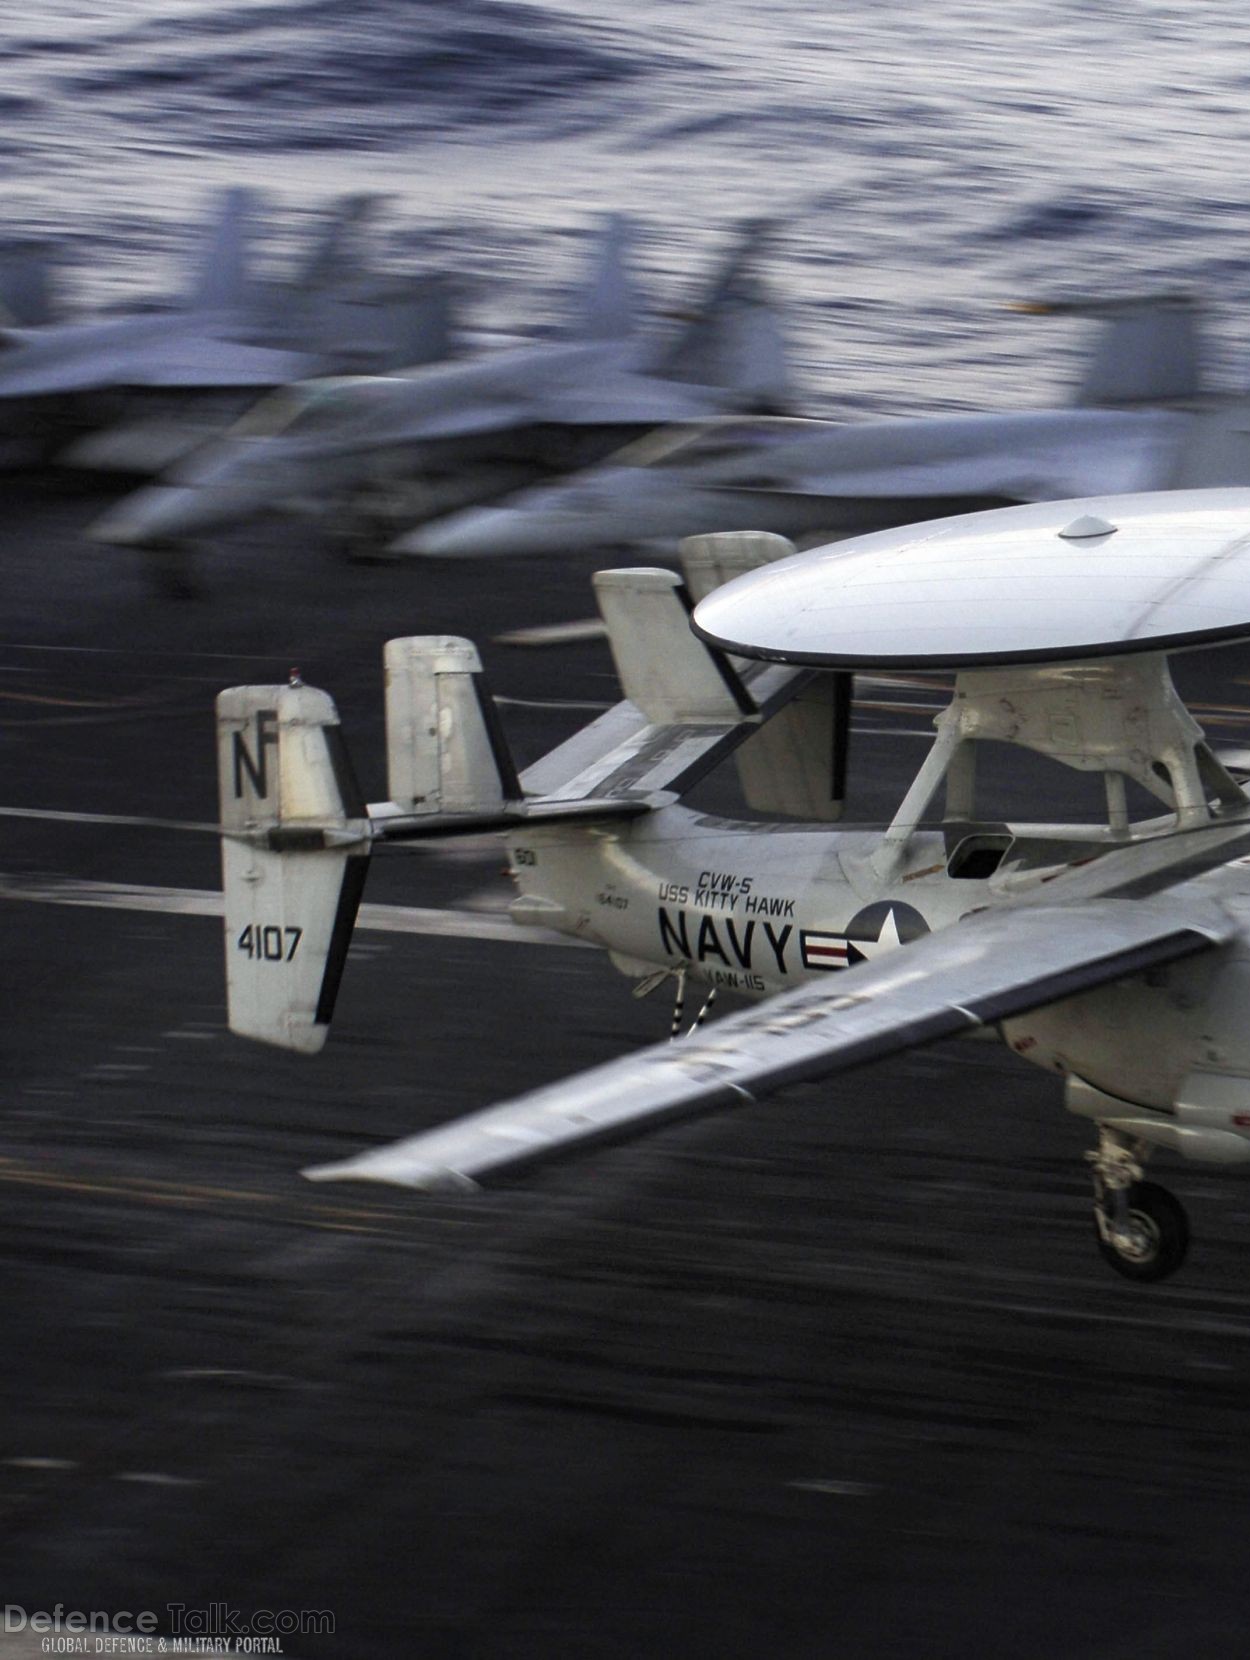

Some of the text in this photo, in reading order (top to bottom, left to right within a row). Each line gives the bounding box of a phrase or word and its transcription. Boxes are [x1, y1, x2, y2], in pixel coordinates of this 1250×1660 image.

[659, 882, 796, 918] USS KITTY HAWK
[698, 871, 754, 894] CVW-5
[238, 924, 304, 963] 4107
[658, 907, 793, 974] NAVY
